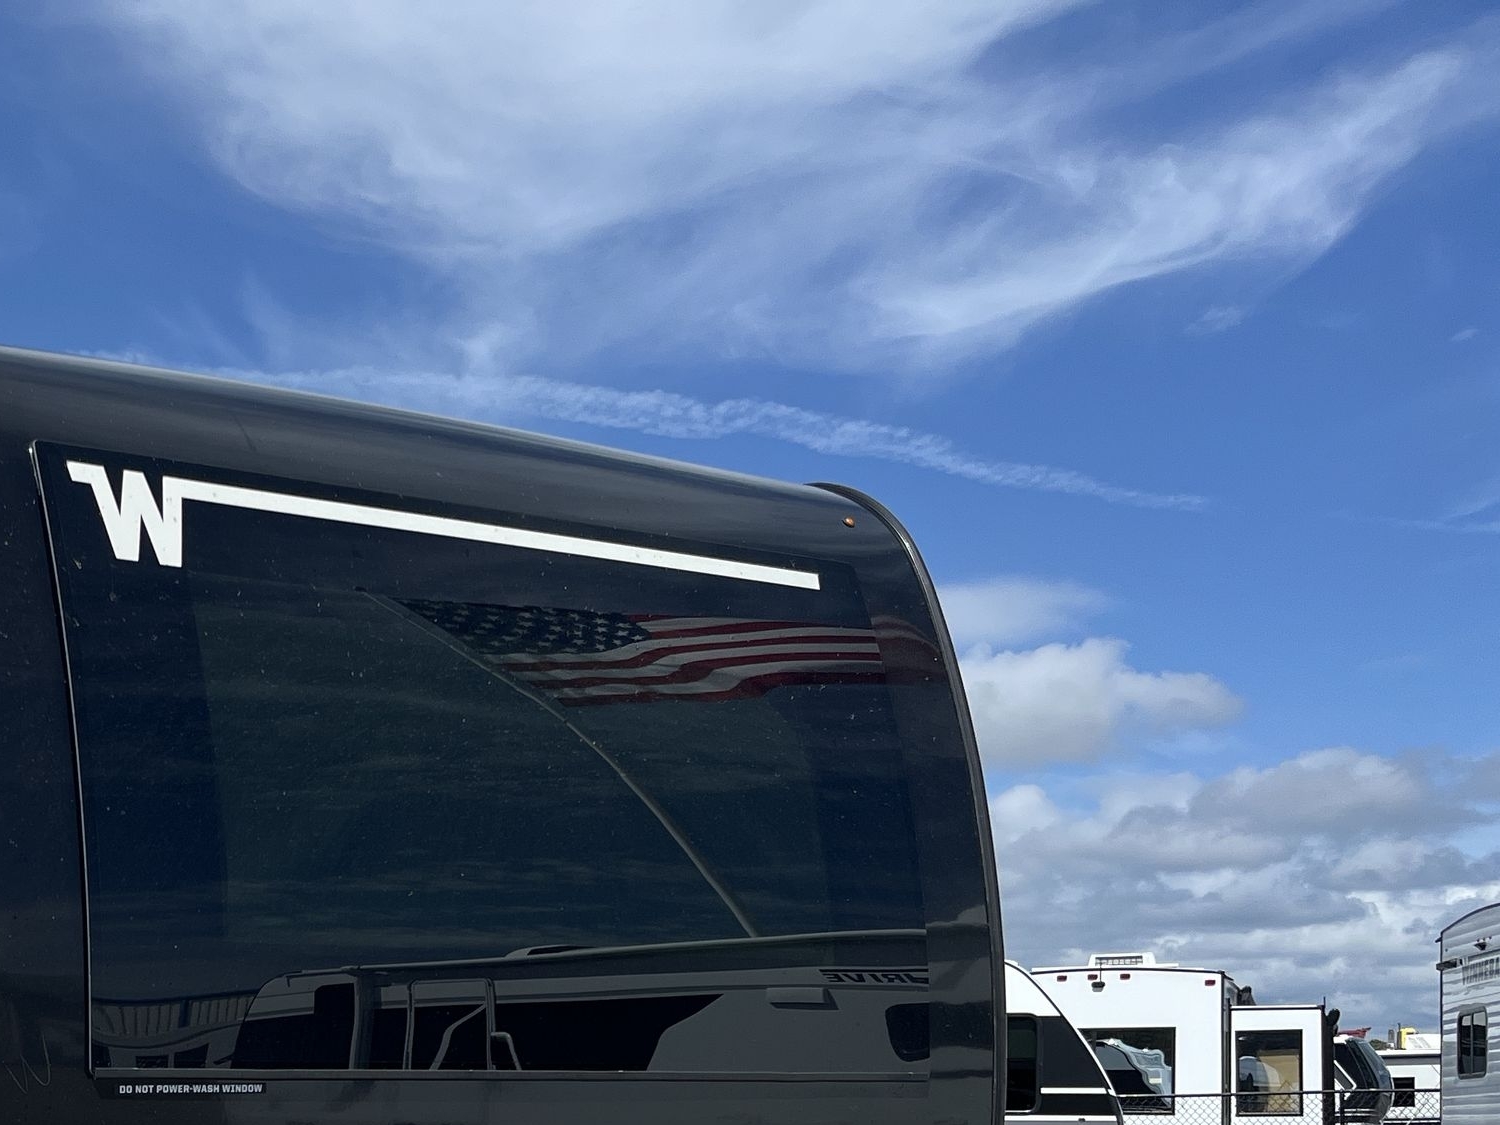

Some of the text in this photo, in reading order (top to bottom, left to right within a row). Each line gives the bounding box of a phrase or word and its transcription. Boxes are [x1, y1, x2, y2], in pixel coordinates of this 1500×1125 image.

[119, 1083, 263, 1094] DO NOT POWER-WASH WINDOW
